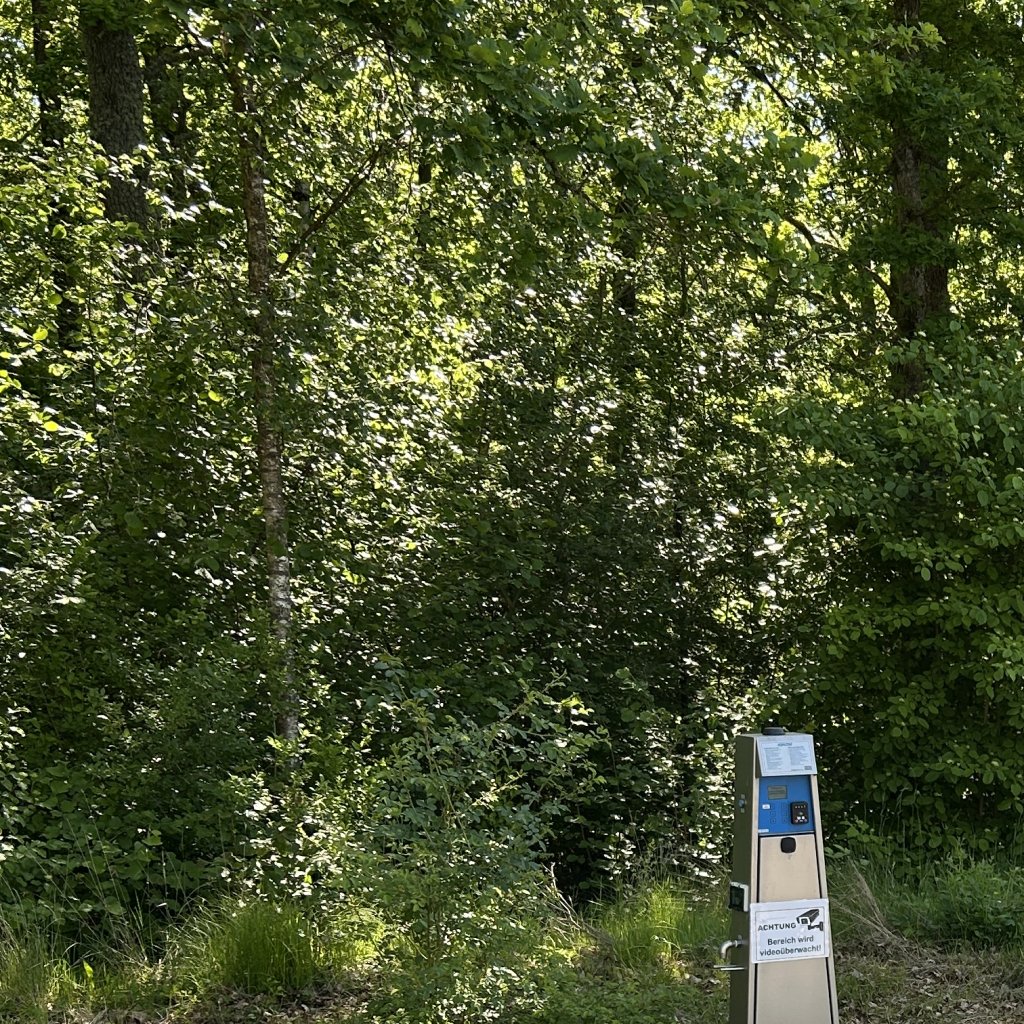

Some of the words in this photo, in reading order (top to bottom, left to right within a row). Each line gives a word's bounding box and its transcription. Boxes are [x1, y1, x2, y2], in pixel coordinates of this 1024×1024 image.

[758, 923, 796, 931] ACHTUNG
[767, 937, 796, 945] Bereich
[798, 935, 814, 943] wird
[760, 945, 821, 956] videoüberwacht!
